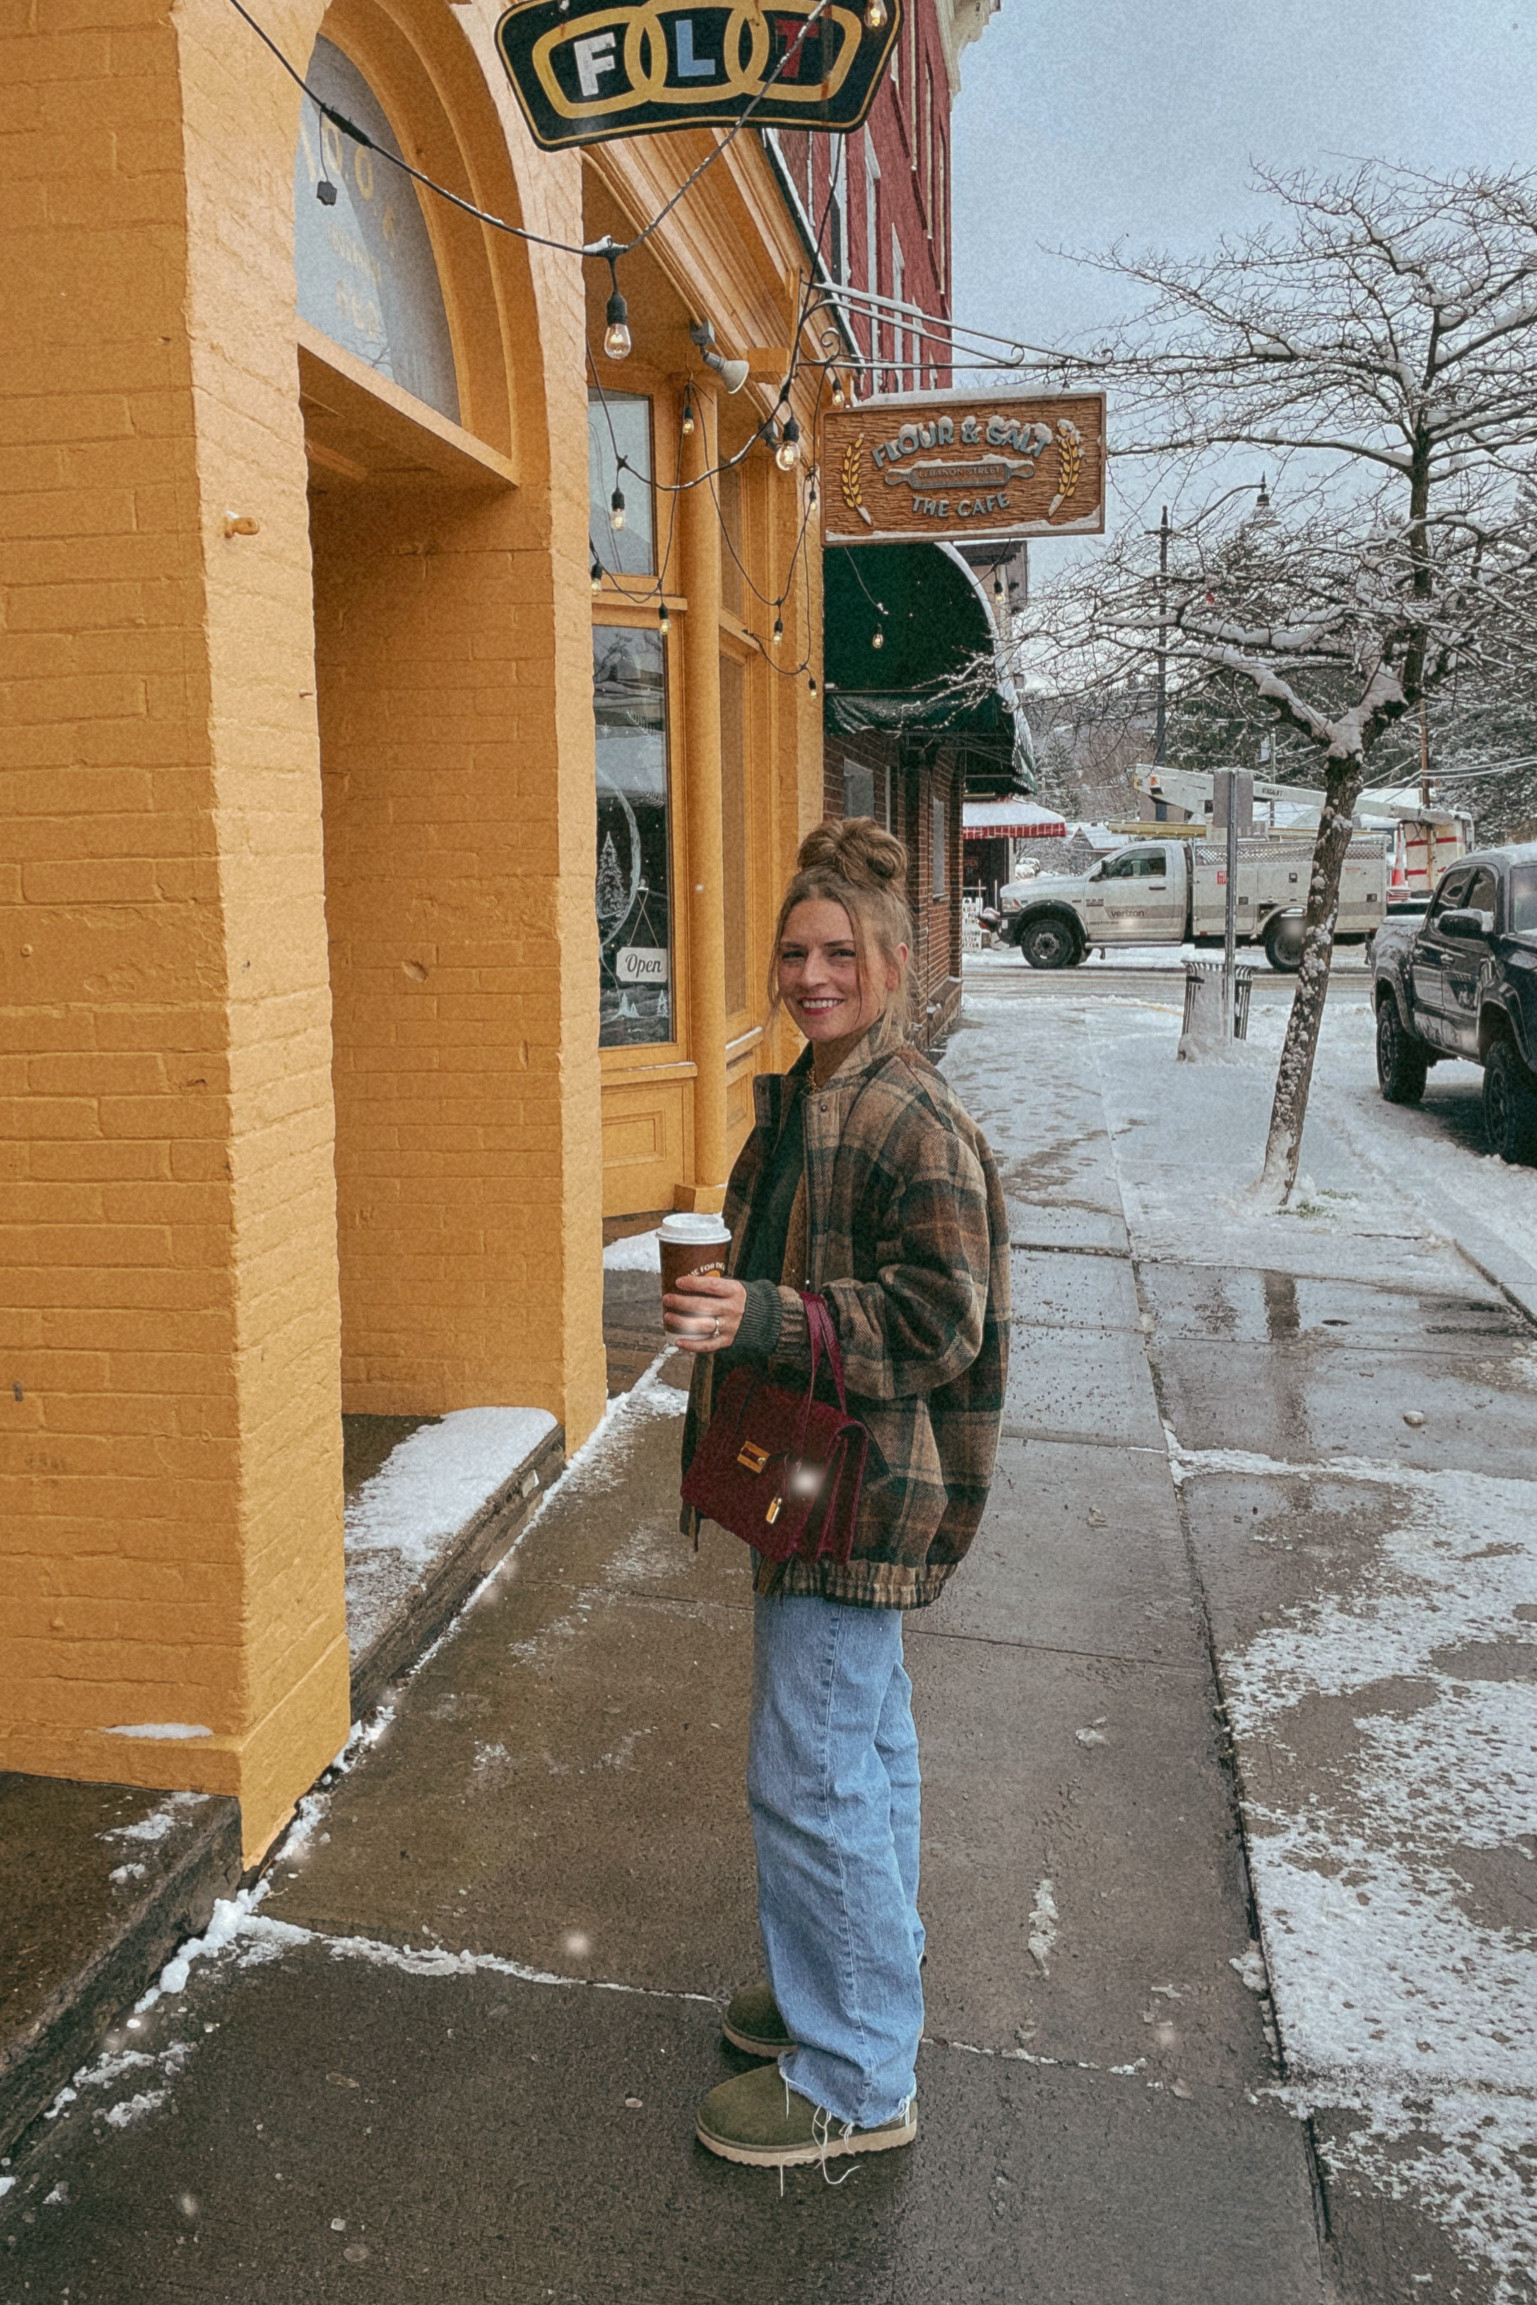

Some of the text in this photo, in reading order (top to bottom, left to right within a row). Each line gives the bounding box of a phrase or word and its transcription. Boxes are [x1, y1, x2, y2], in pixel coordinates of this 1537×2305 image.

[872, 415, 1050, 468] FLOUR & SALT
[919, 466, 1000, 478] LEBANON STREET
[912, 491, 1011, 518] THE CAFE
[624, 953, 663, 978] Open
